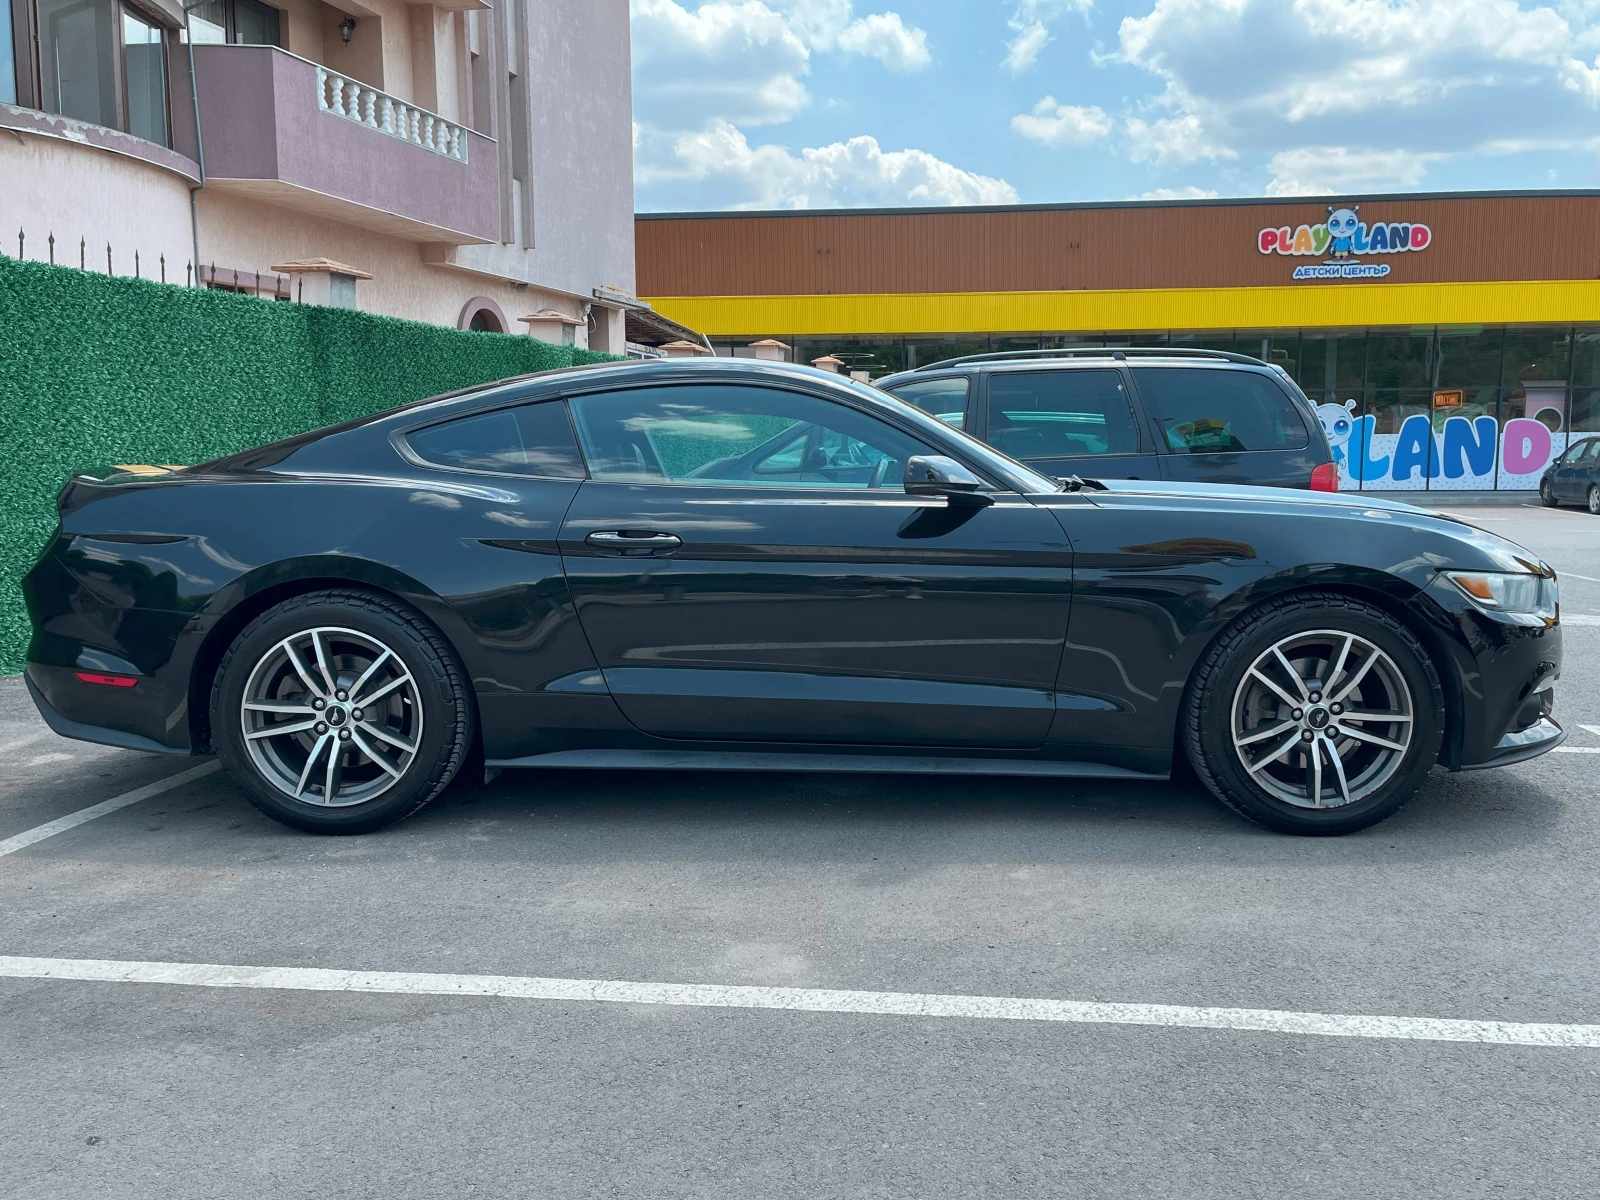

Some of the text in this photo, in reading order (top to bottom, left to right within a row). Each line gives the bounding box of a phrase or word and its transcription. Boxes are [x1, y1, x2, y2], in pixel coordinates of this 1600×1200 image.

[1260, 225, 1429, 253] PLAY LAND
[1295, 266, 1388, 277] ДЕТСКИ ЦЕНТЪР
[1347, 415, 1551, 481] LAND
